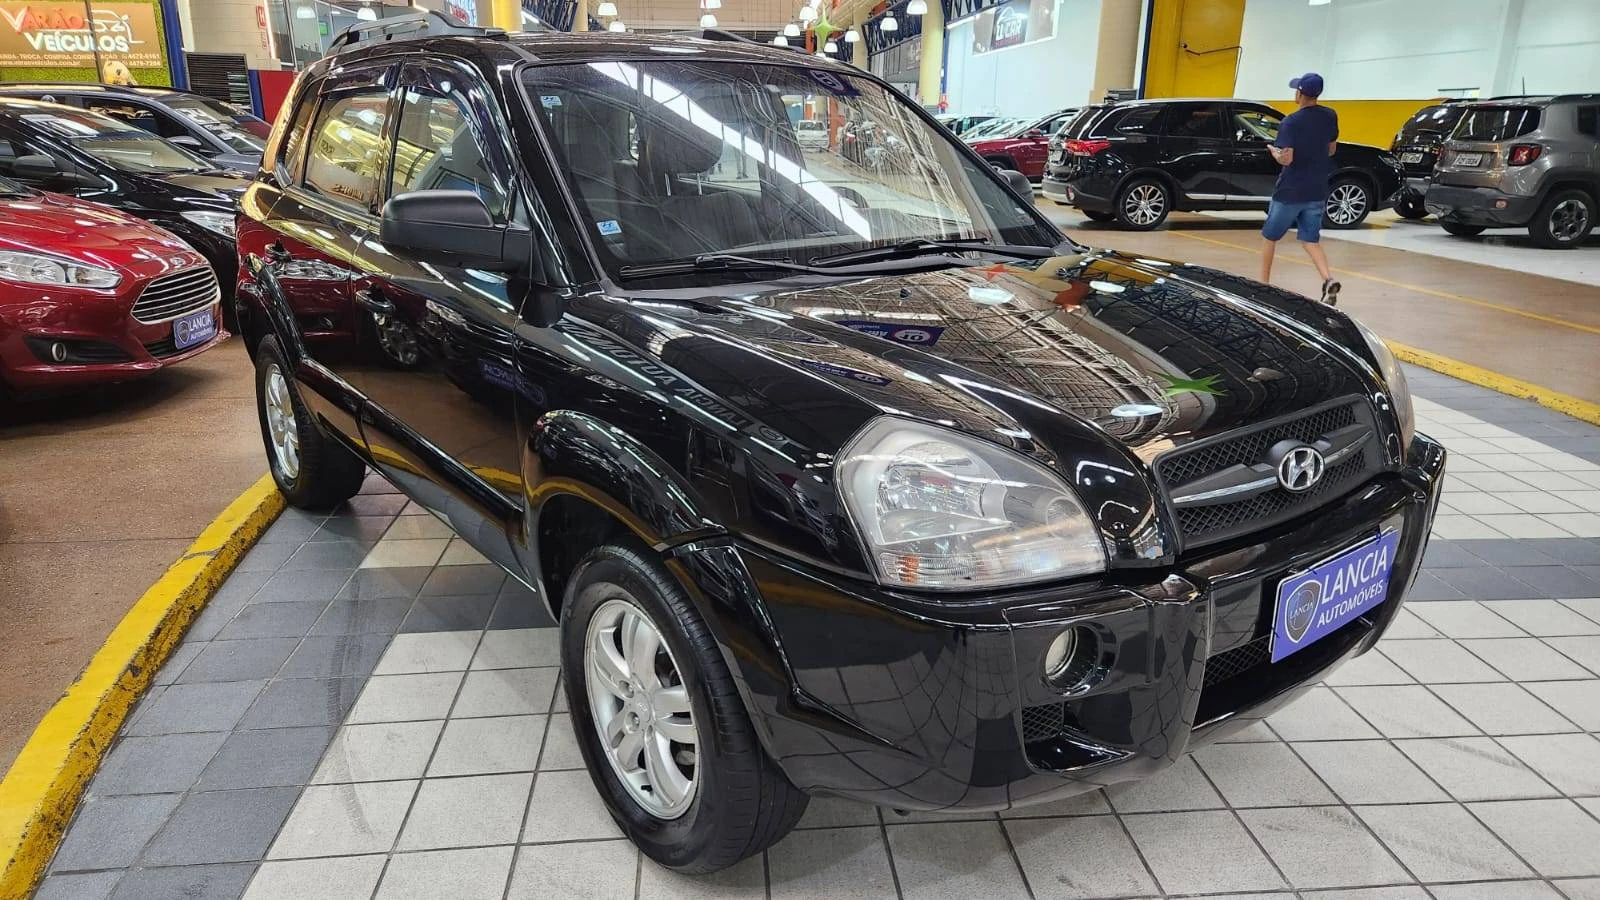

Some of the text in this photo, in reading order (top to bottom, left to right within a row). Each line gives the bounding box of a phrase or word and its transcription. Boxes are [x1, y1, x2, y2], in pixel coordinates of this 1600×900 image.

[24, 31, 129, 52] VEÍCULOS
[189, 313, 212, 331] LANCIA
[1321, 545, 1388, 605] LANCIA
[1289, 602, 1314, 620] LANCIA
[1316, 579, 1384, 628] AUTOMÓVEIS
